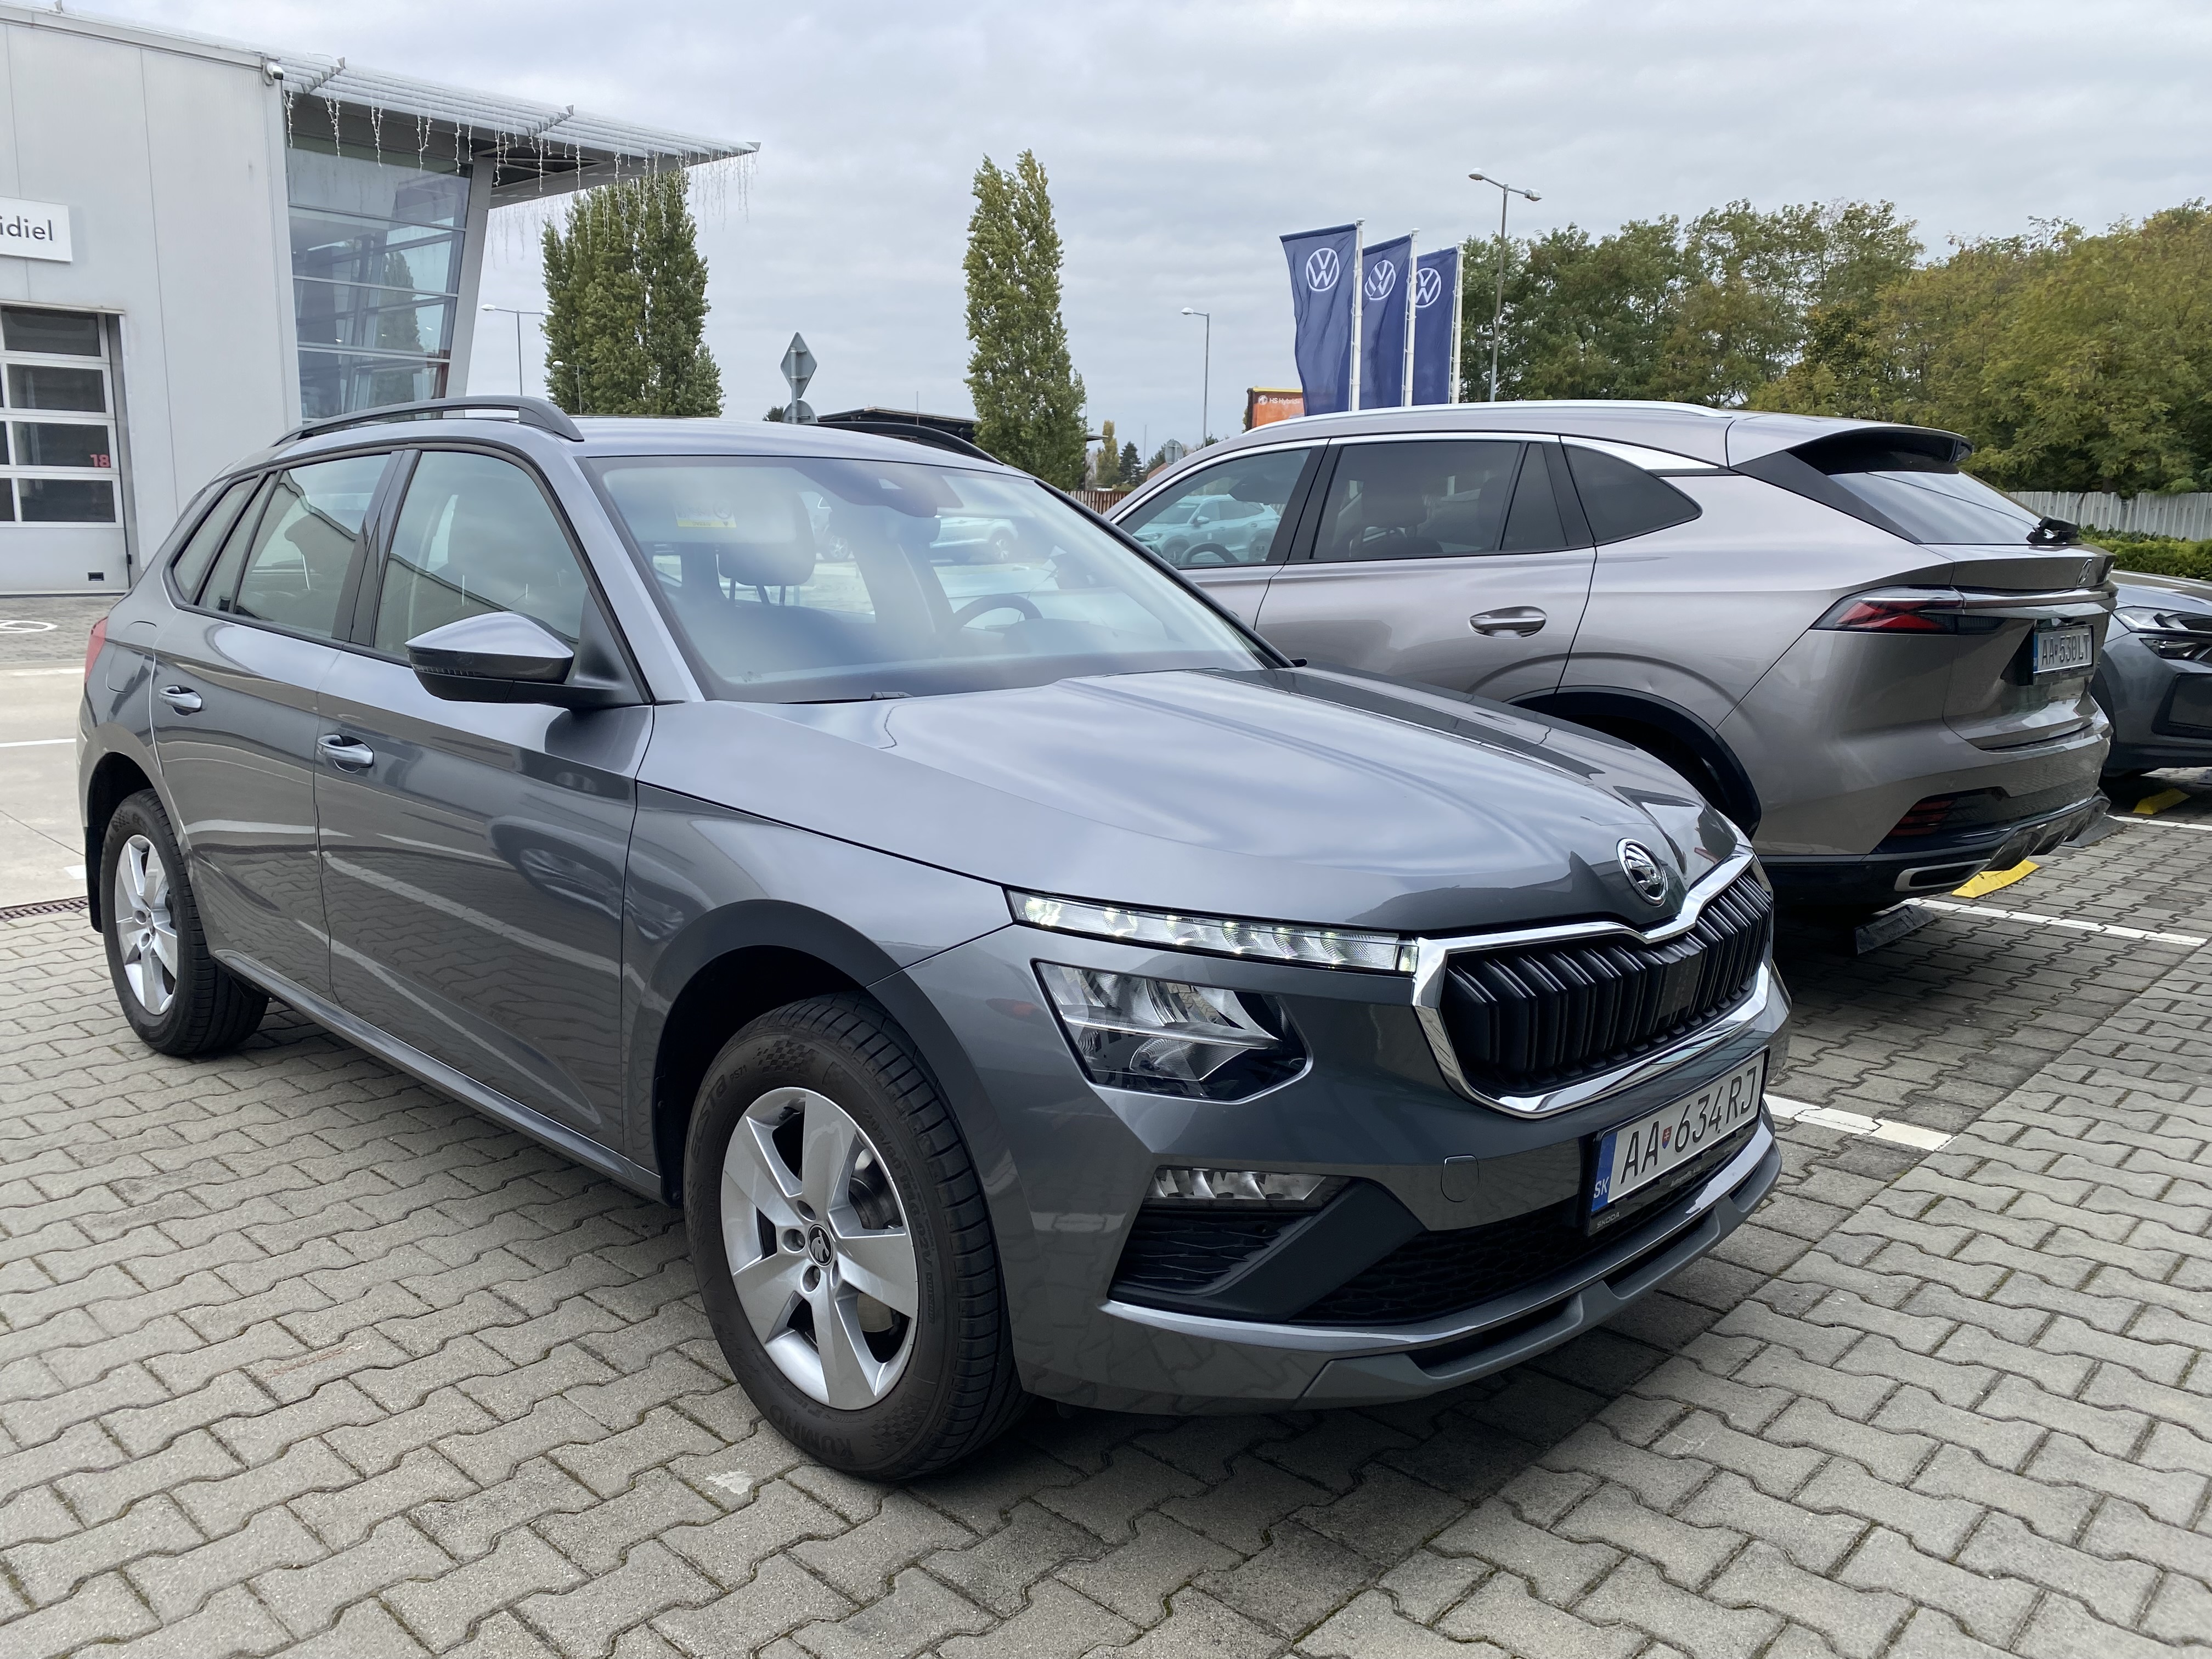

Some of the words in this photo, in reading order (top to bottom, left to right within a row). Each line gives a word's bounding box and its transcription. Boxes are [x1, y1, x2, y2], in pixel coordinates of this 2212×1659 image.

[0, 215, 53, 241] idiel
[90, 454, 111, 467] 18
[1621, 1121, 1660, 1184] AA
[1594, 1176, 1610, 1199] SK
